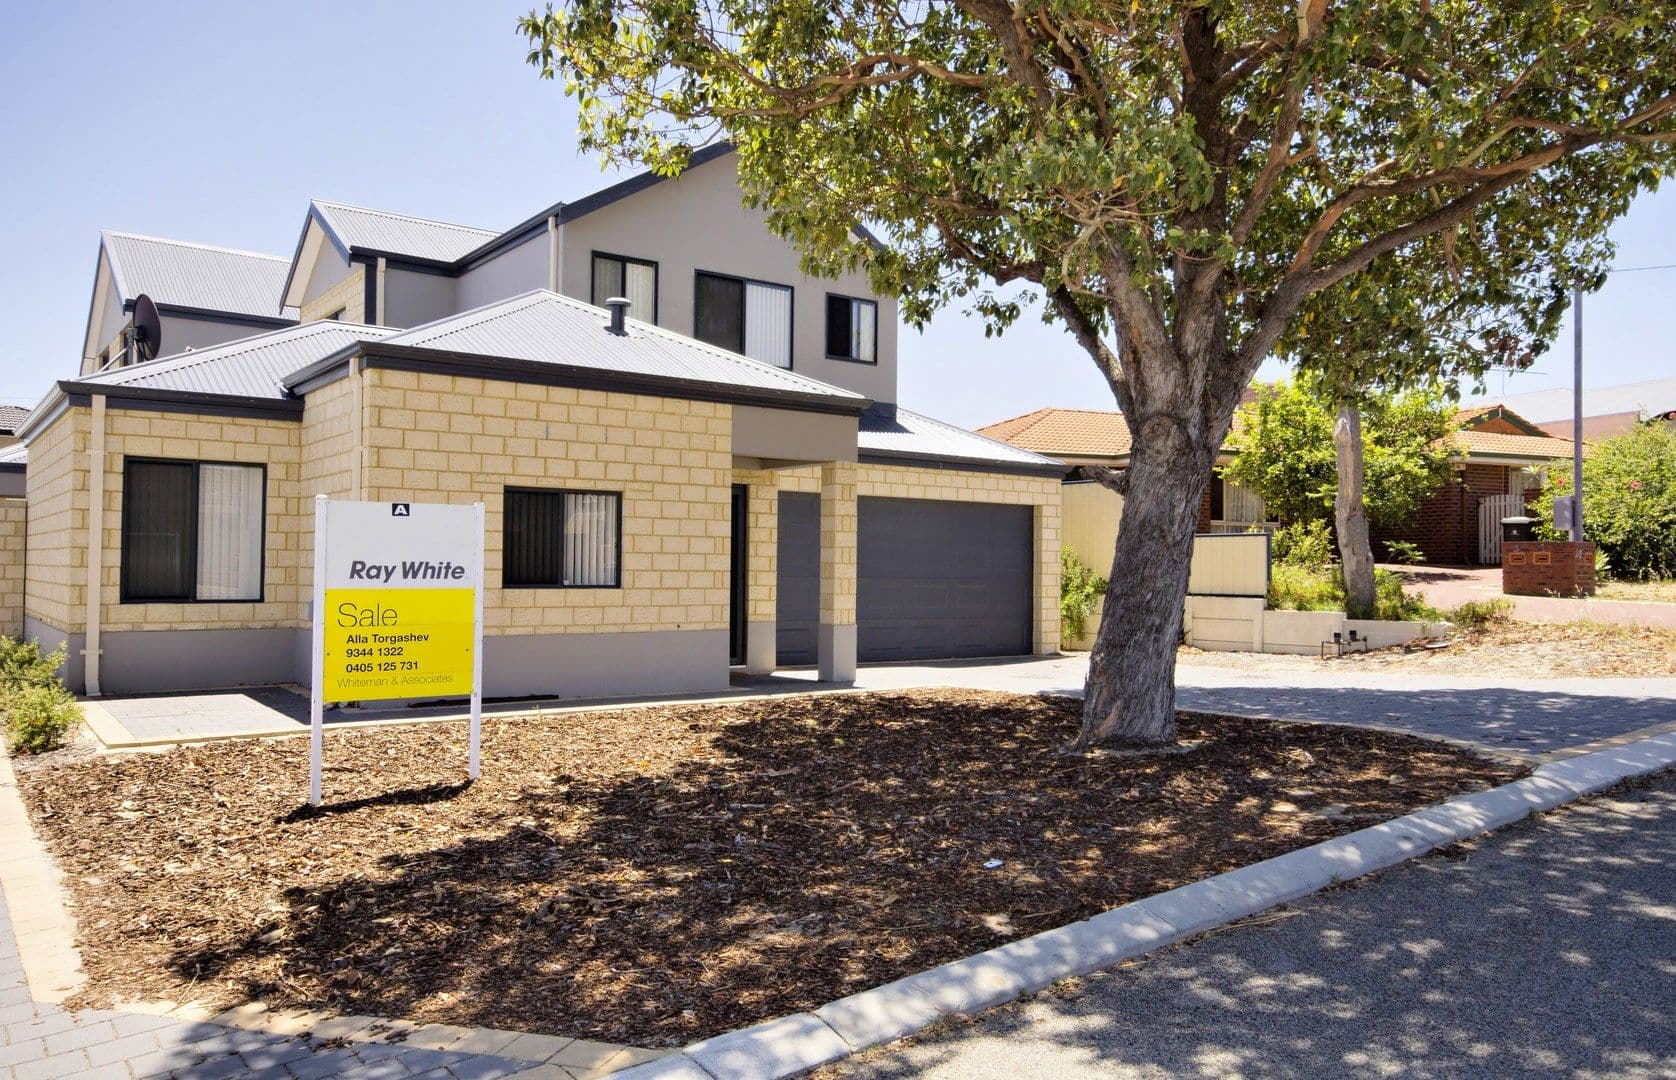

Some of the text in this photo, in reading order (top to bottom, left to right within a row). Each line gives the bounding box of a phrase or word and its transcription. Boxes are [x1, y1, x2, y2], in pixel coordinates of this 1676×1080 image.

[394, 504, 408, 516] A
[349, 560, 466, 583] Ray White
[337, 602, 398, 627] Sale
[346, 633, 429, 644] Alla Torgashev
[346, 646, 404, 658] 9344 1322
[346, 661, 418, 673] 0405 125 731
[337, 674, 453, 688] Whiteman & Associates
